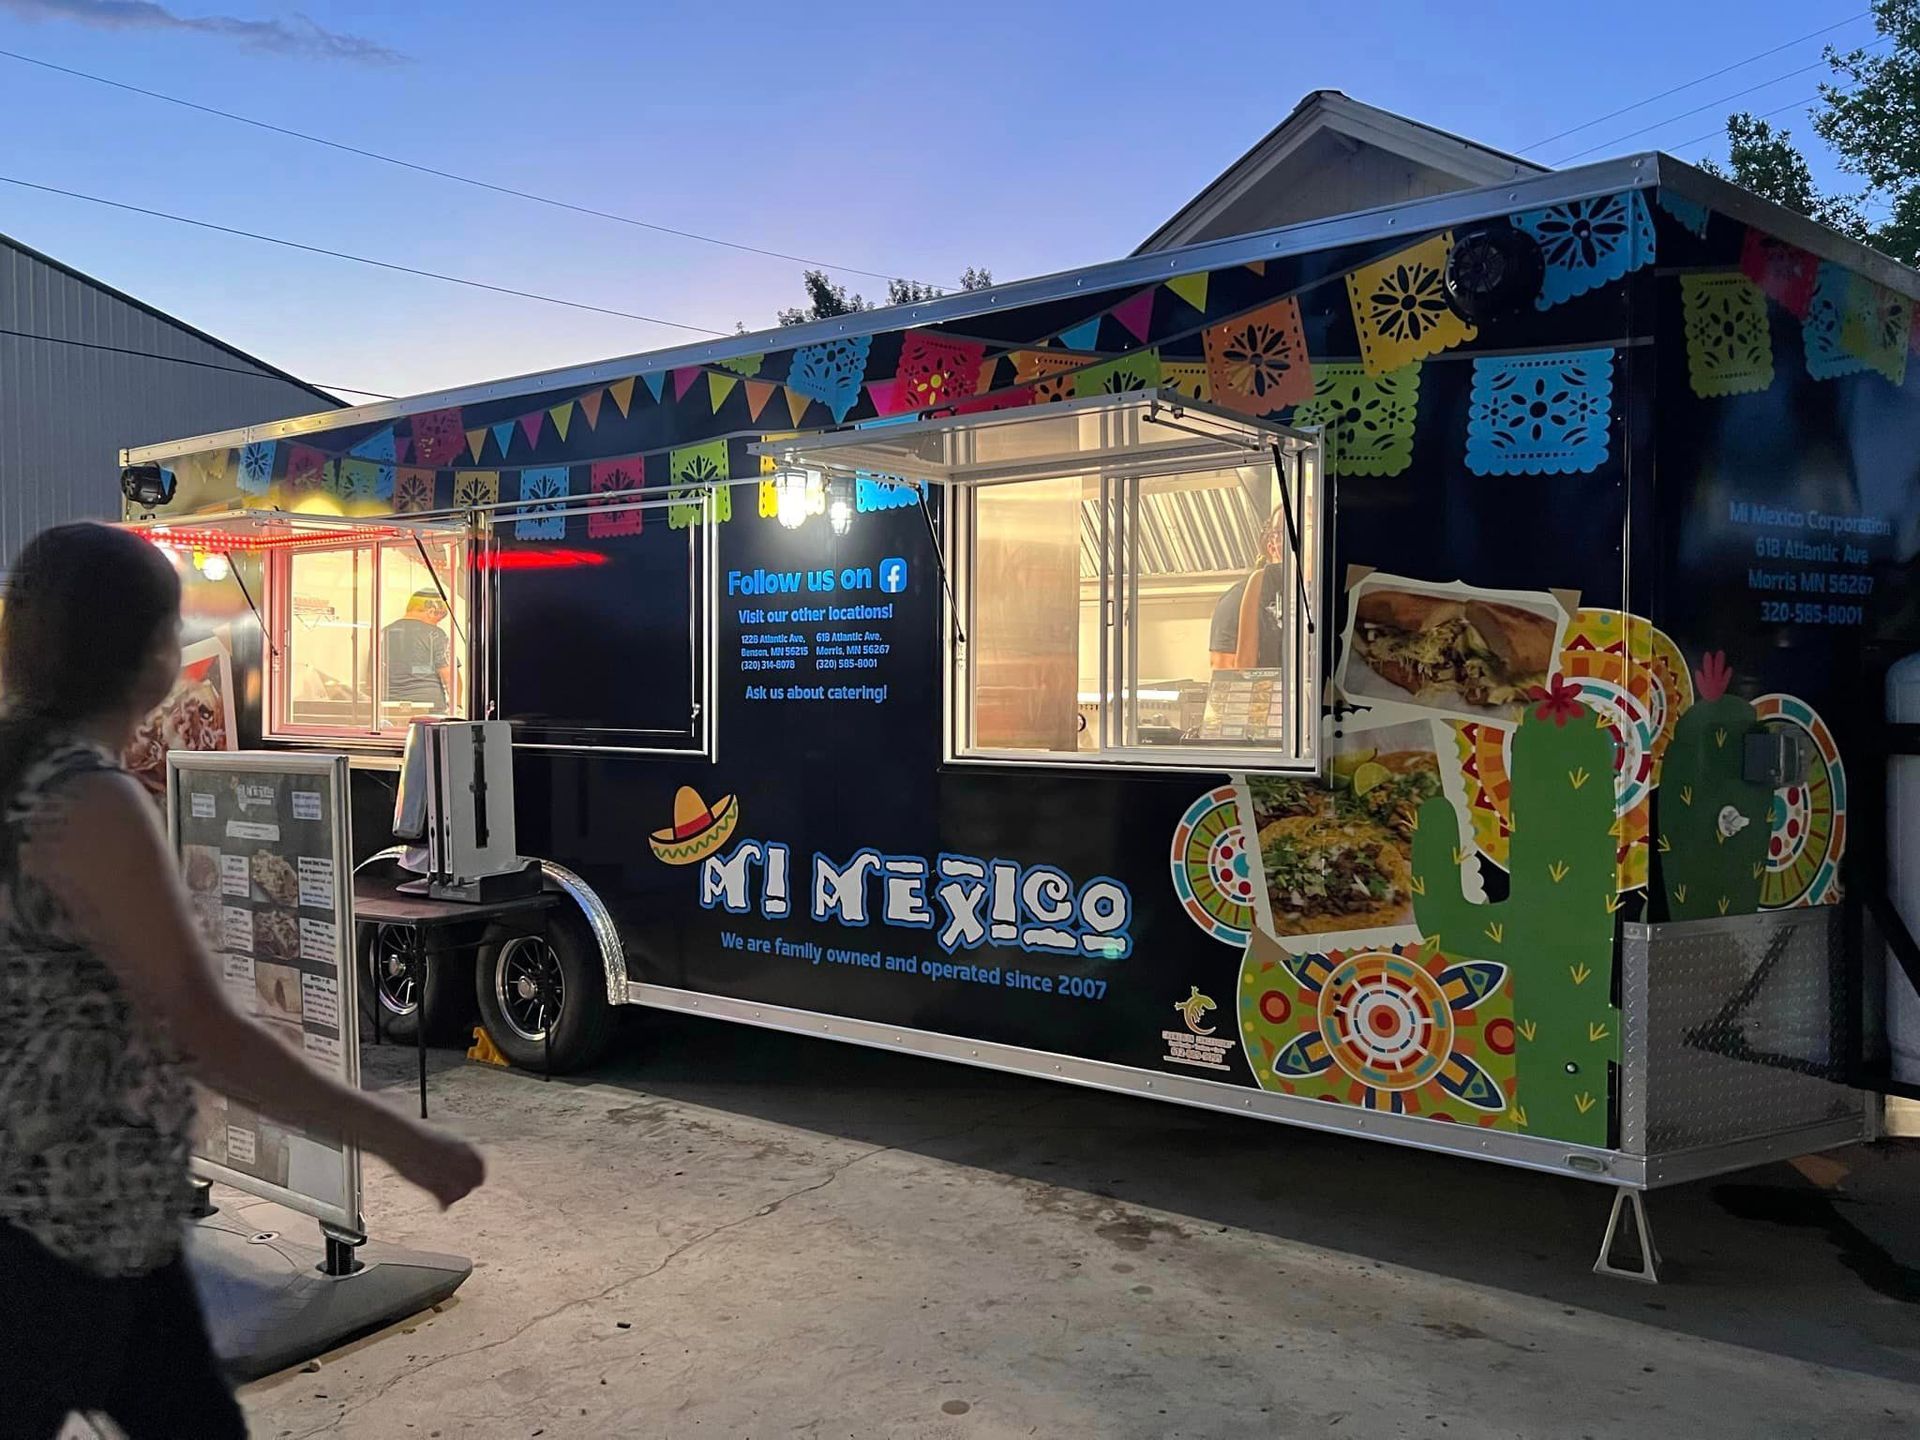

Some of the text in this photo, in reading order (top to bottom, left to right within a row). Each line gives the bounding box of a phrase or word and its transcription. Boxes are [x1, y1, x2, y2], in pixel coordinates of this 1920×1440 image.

[1751, 504, 1804, 528] Mexico
[1807, 510, 1890, 537] Corporation
[1756, 536, 1868, 564] 618 Atlantic Ave
[728, 569, 801, 596] Follow
[807, 569, 835, 592] us
[840, 567, 872, 590] on
[1748, 569, 1874, 595] Morris MN 56267
[738, 603, 893, 624] Visit our other locations!
[1760, 600, 1863, 625] 320-585-8001
[760, 634, 788, 644] Atlantic
[816, 632, 830, 642] 618
[832, 631, 863, 642] Atlantic
[770, 647, 784, 656] MN
[785, 646, 809, 656] 56215
[816, 644, 890, 656] Morris, MN 56267
[740, 660, 761, 672] (320)
[816, 658, 878, 670] (320) 585-8001
[745, 684, 888, 704] Ask us about catering!
[812, 850, 1131, 957] MEXICO
[721, 931, 1107, 1000] We are family owned and operated since 2007
